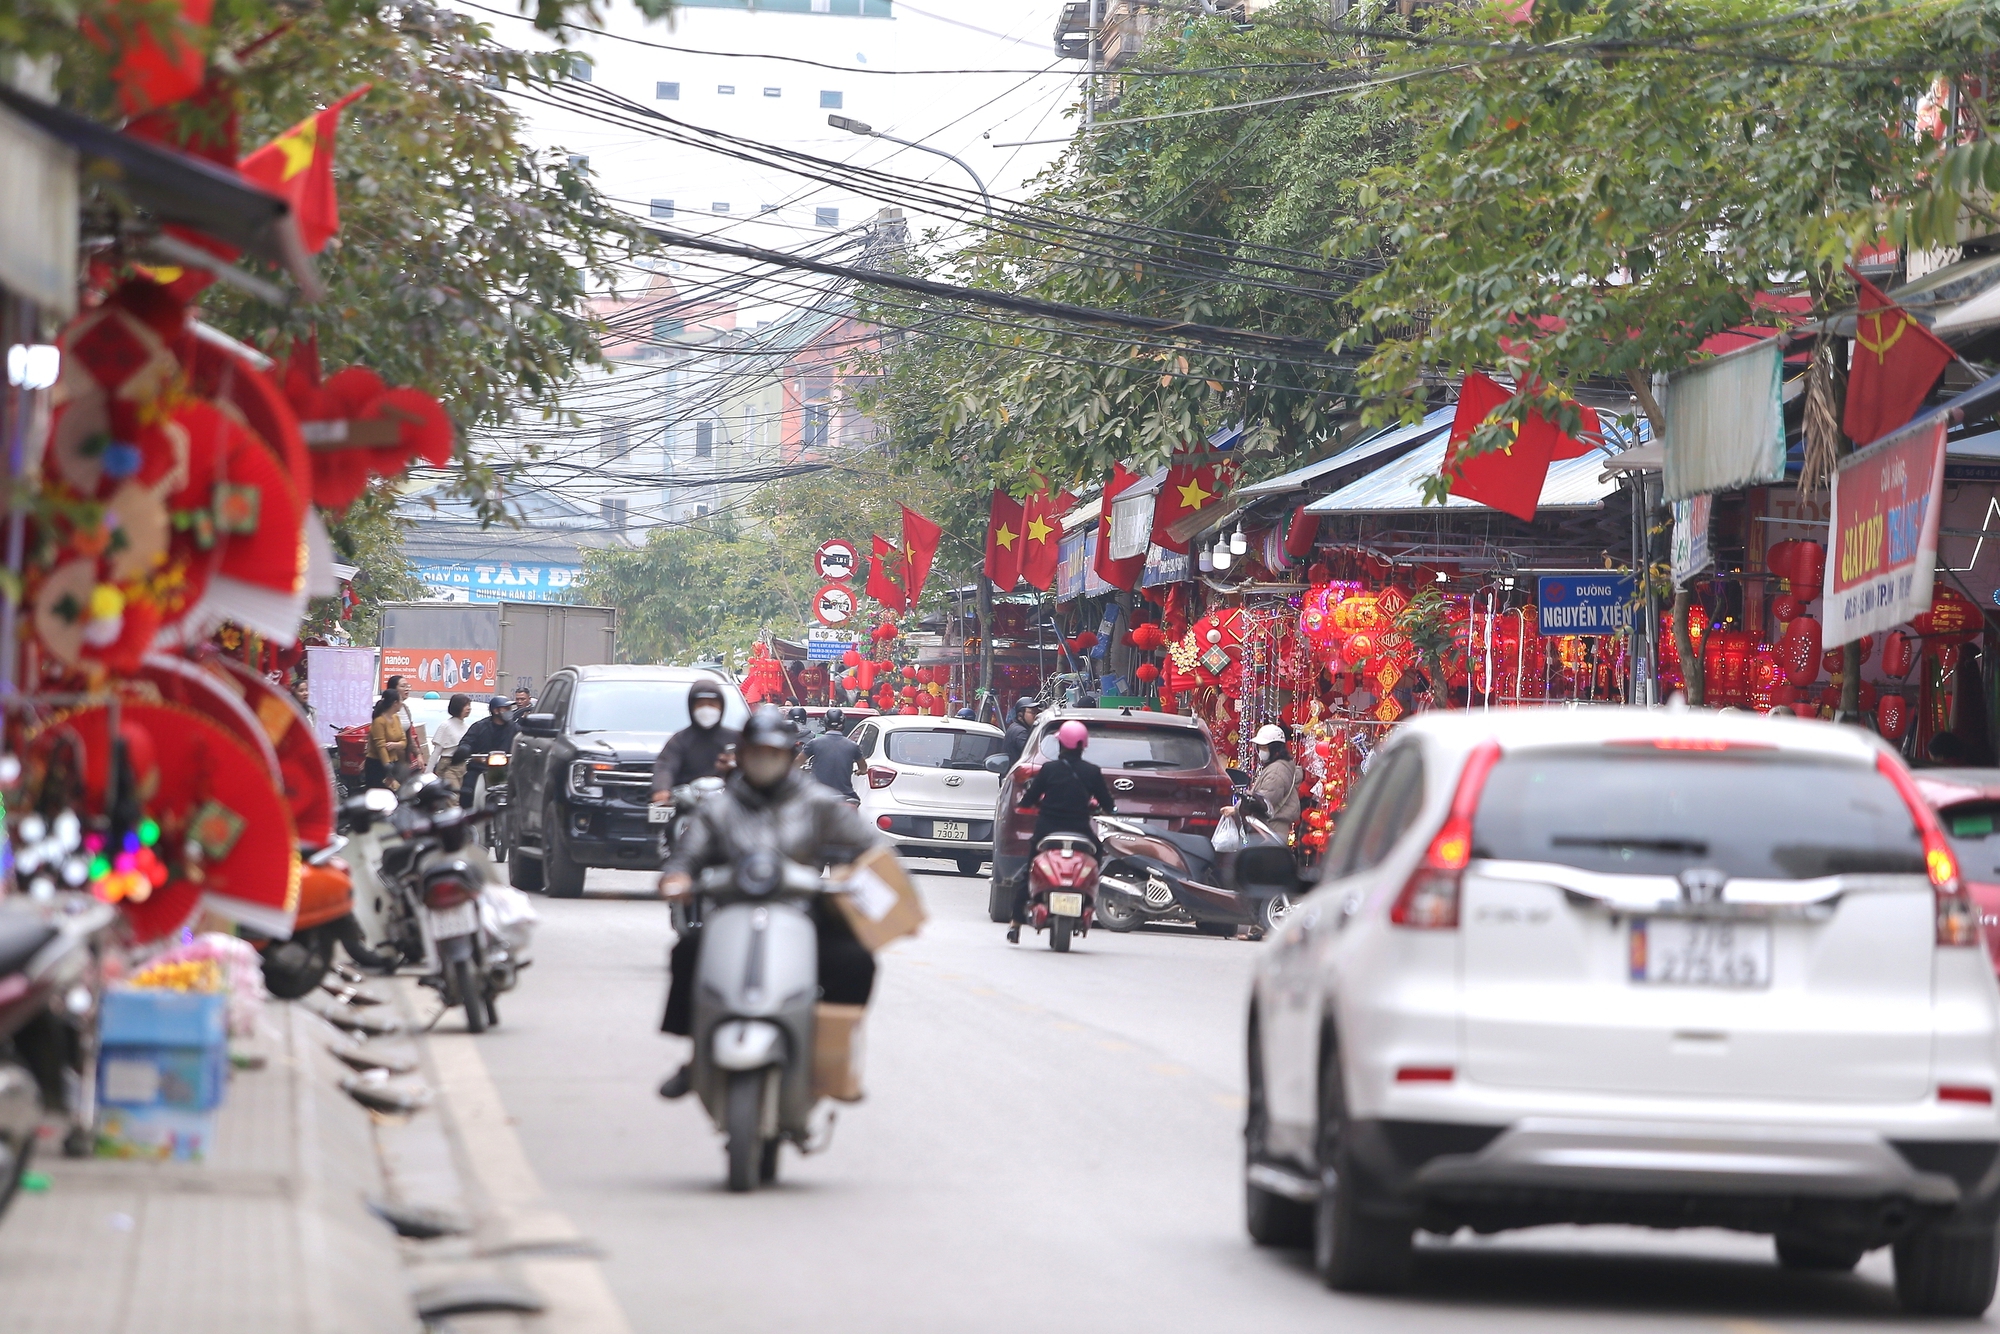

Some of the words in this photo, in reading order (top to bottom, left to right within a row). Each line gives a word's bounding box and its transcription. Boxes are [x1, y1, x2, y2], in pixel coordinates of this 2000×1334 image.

[453, 573, 470, 583] DA
[476, 561, 543, 586] TÂN
[1576, 583, 1612, 596] ĐƯỜNG
[1543, 600, 1597, 628] NGUYỄN
[1600, 596, 1632, 626] XIỂN
[517, 676, 533, 689] 37C
[943, 822, 959, 831] 37A
[937, 830, 965, 839] 730.27
